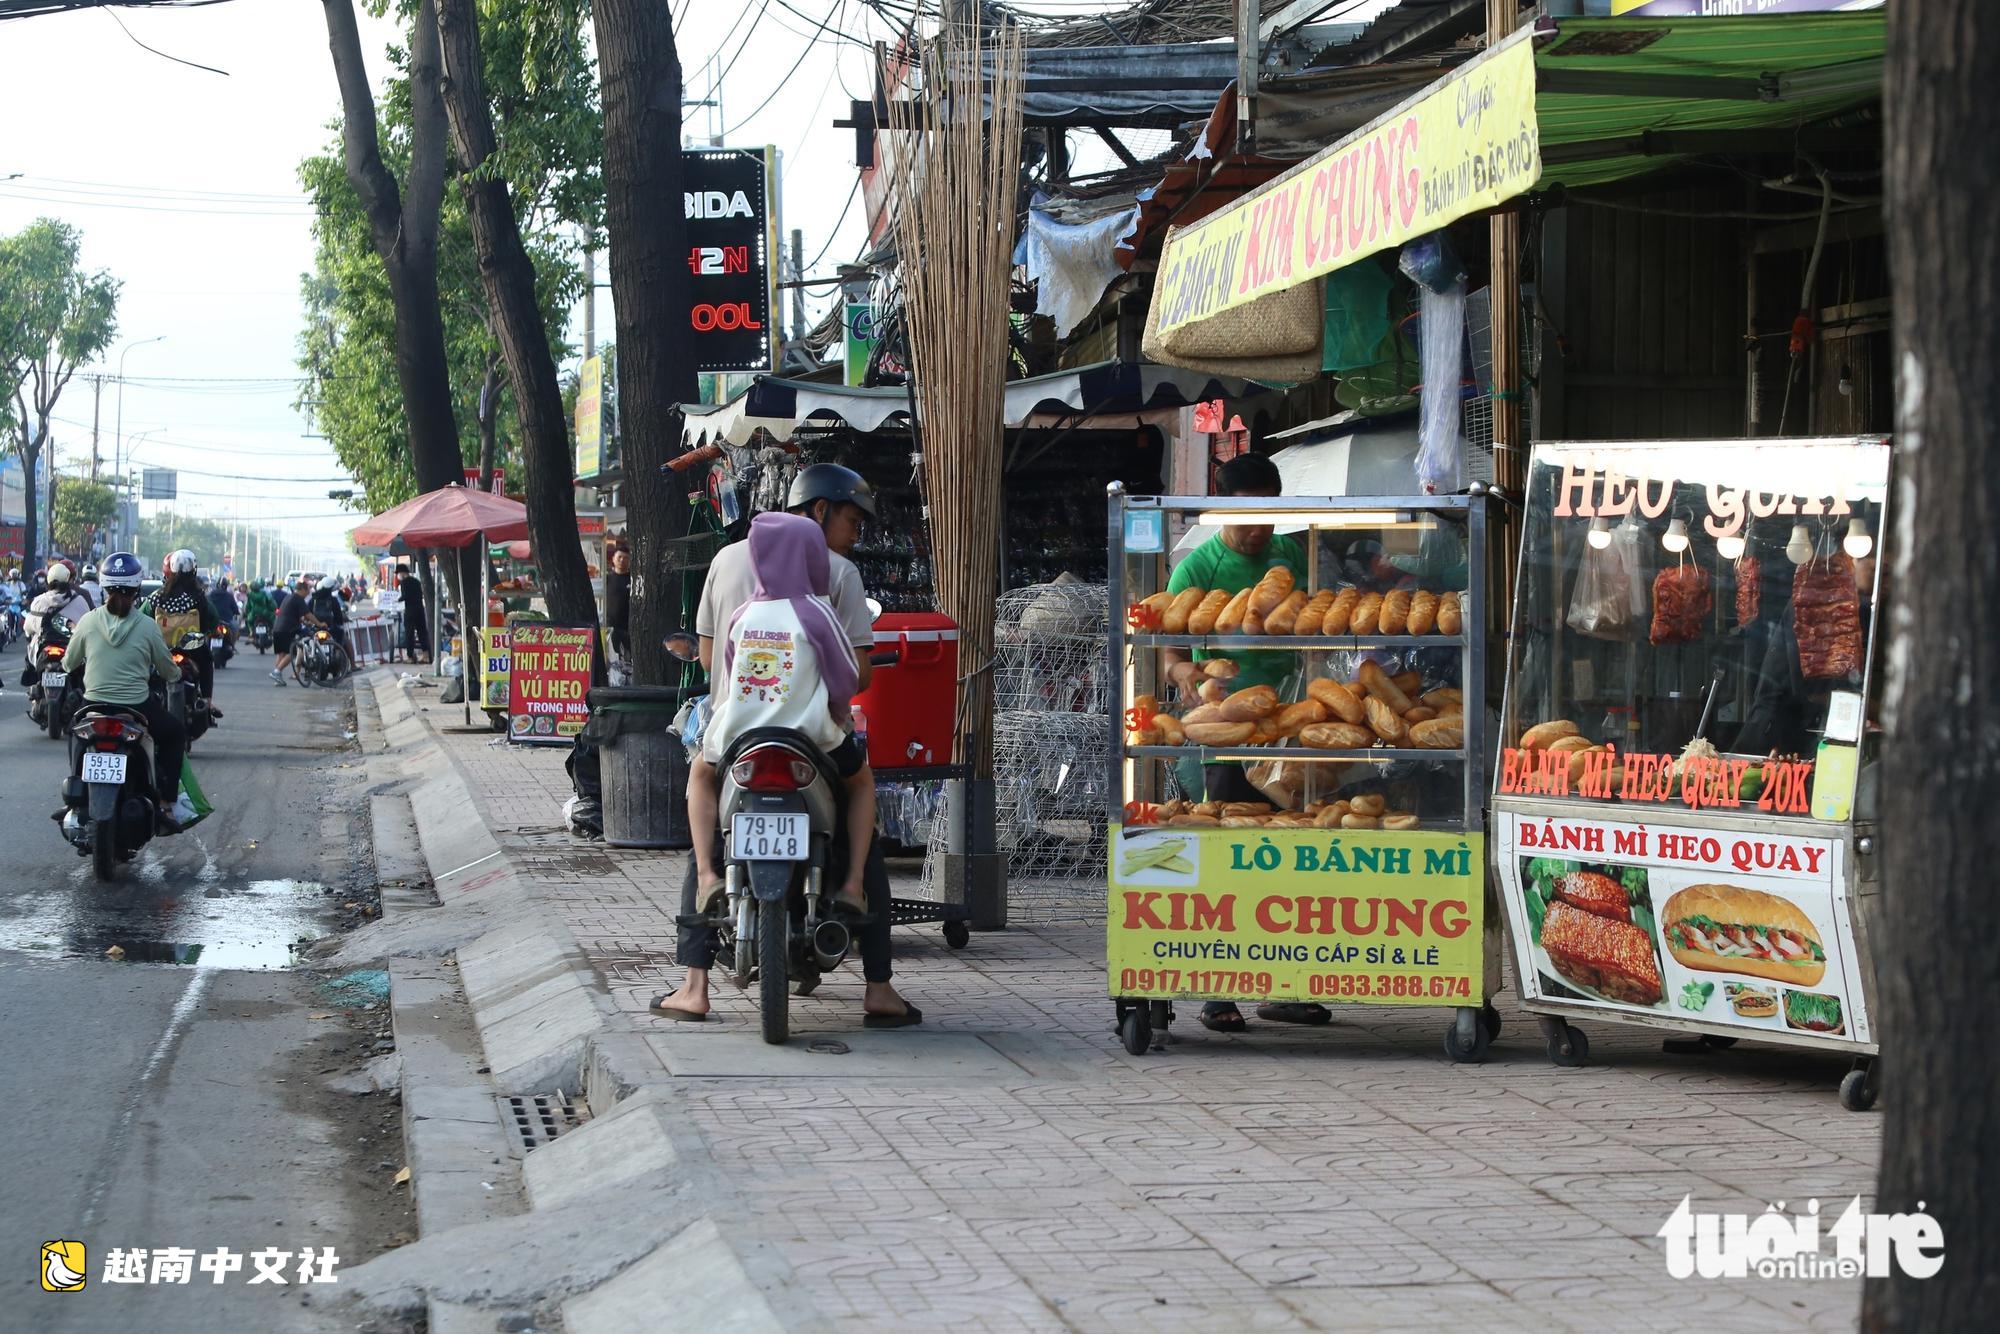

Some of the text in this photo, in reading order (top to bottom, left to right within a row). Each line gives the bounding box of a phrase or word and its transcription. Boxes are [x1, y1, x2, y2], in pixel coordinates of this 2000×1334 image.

[1423, 165, 1455, 217] BÁNH
[1457, 149, 1470, 201] MÌ
[1238, 178, 1303, 295] KIM
[1304, 116, 1420, 268] CHUNG
[691, 303, 761, 331] OOL
[513, 647, 590, 676] THỊT DÊ TƯƠI
[519, 674, 582, 700] VÚ HEO
[526, 701, 564, 713] TRONG
[88, 768, 122, 781] 165.75
[90, 755, 121, 769] 59-L3
[1502, 736, 1812, 813] BÁNH MÌ HEO QUAY 20K
[744, 816, 795, 835] 79-U1
[1124, 800, 1158, 825] 2k
[744, 837, 797, 856] 4048
[1230, 837, 1472, 876] LÒ BÁNH MÌ
[1519, 818, 1826, 874] BÁNH MÌ HEO QUAY
[1122, 891, 1472, 938] KIM CHUNG
[1153, 939, 1439, 966] CHUYÊN CUNG CẤP SỈ & LẺ
[1121, 968, 1273, 995] 0917.117789
[1309, 974, 1471, 998] 0933.388.674
